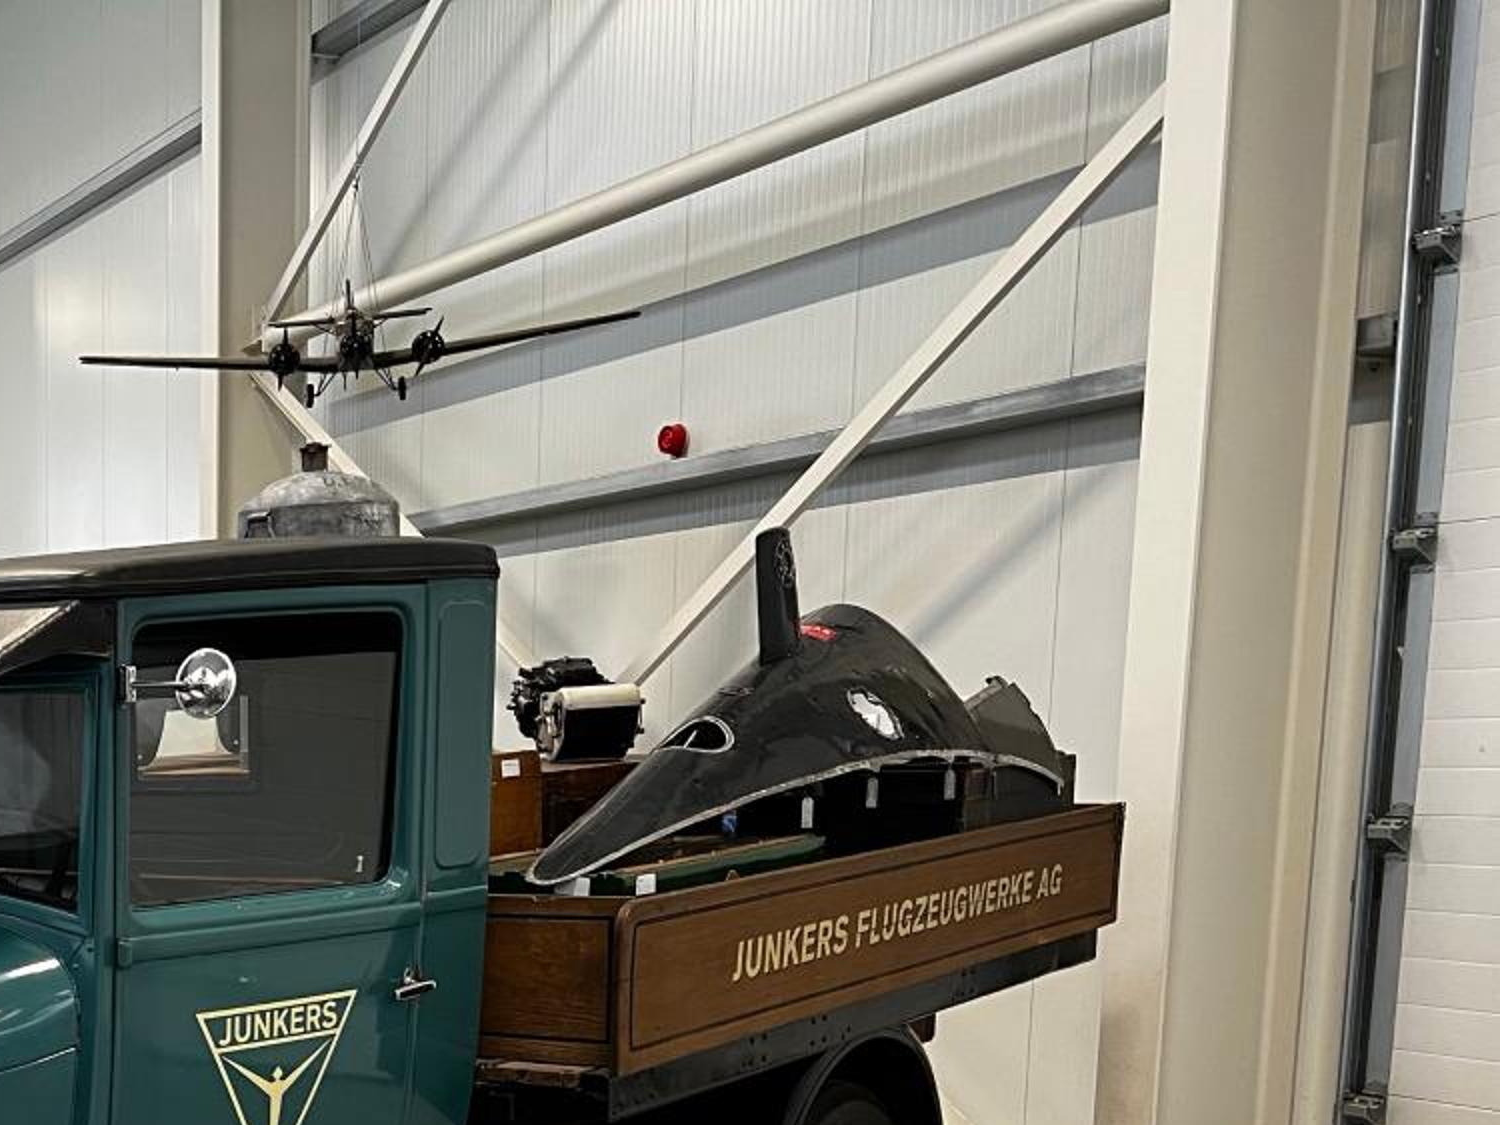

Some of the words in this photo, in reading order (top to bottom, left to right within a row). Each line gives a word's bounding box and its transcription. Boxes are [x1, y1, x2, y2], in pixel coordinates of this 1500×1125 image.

[733, 915, 849, 982] JUNKERS
[855, 870, 1034, 948] FLUGZEUGWERKE
[1036, 863, 1063, 900] AG
[219, 1001, 338, 1047] JUNKERS
